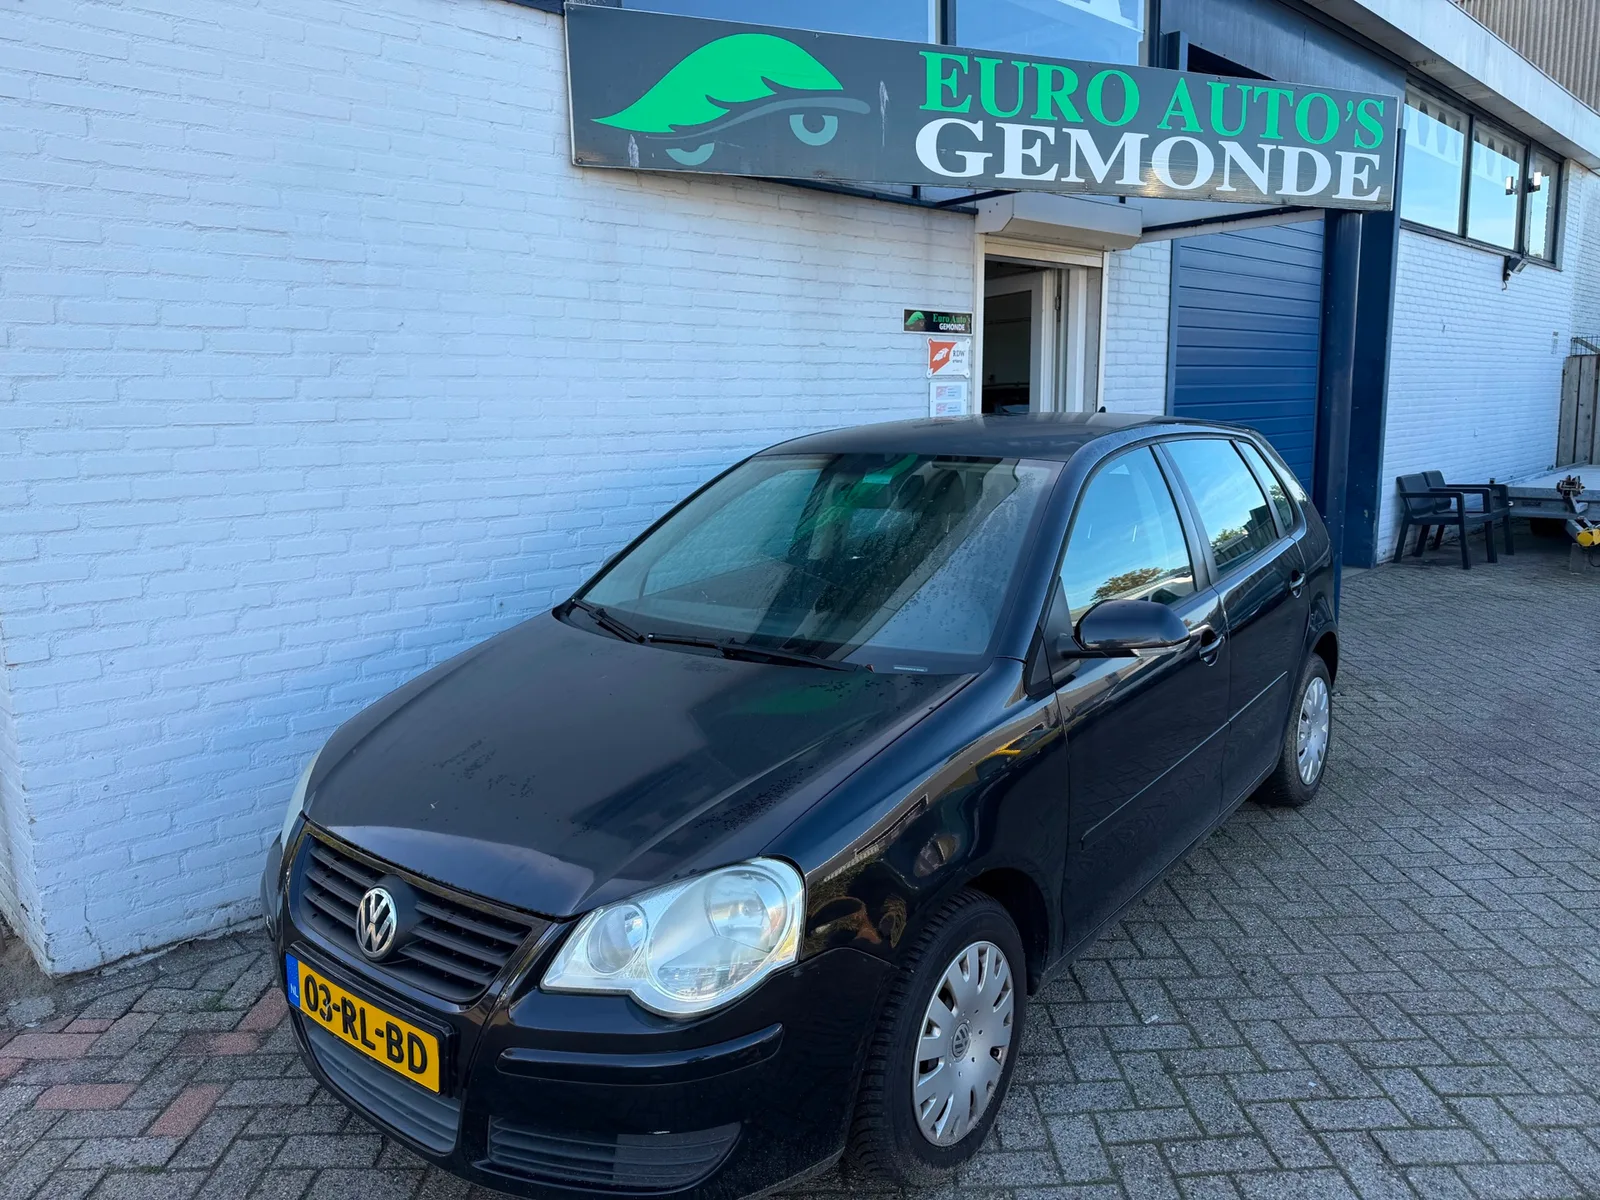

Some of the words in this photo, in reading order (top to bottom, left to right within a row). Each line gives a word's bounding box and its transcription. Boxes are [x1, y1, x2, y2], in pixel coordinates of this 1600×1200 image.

[919, 51, 1140, 127] EURO
[1156, 77, 1384, 150] AUTO'S
[915, 117, 1382, 202] GEMONDE
[932, 313, 950, 323] Euro
[939, 323, 966, 331] GEMONDE
[290, 983, 299, 998] NL
[304, 974, 428, 1075] 03-RL-BD
